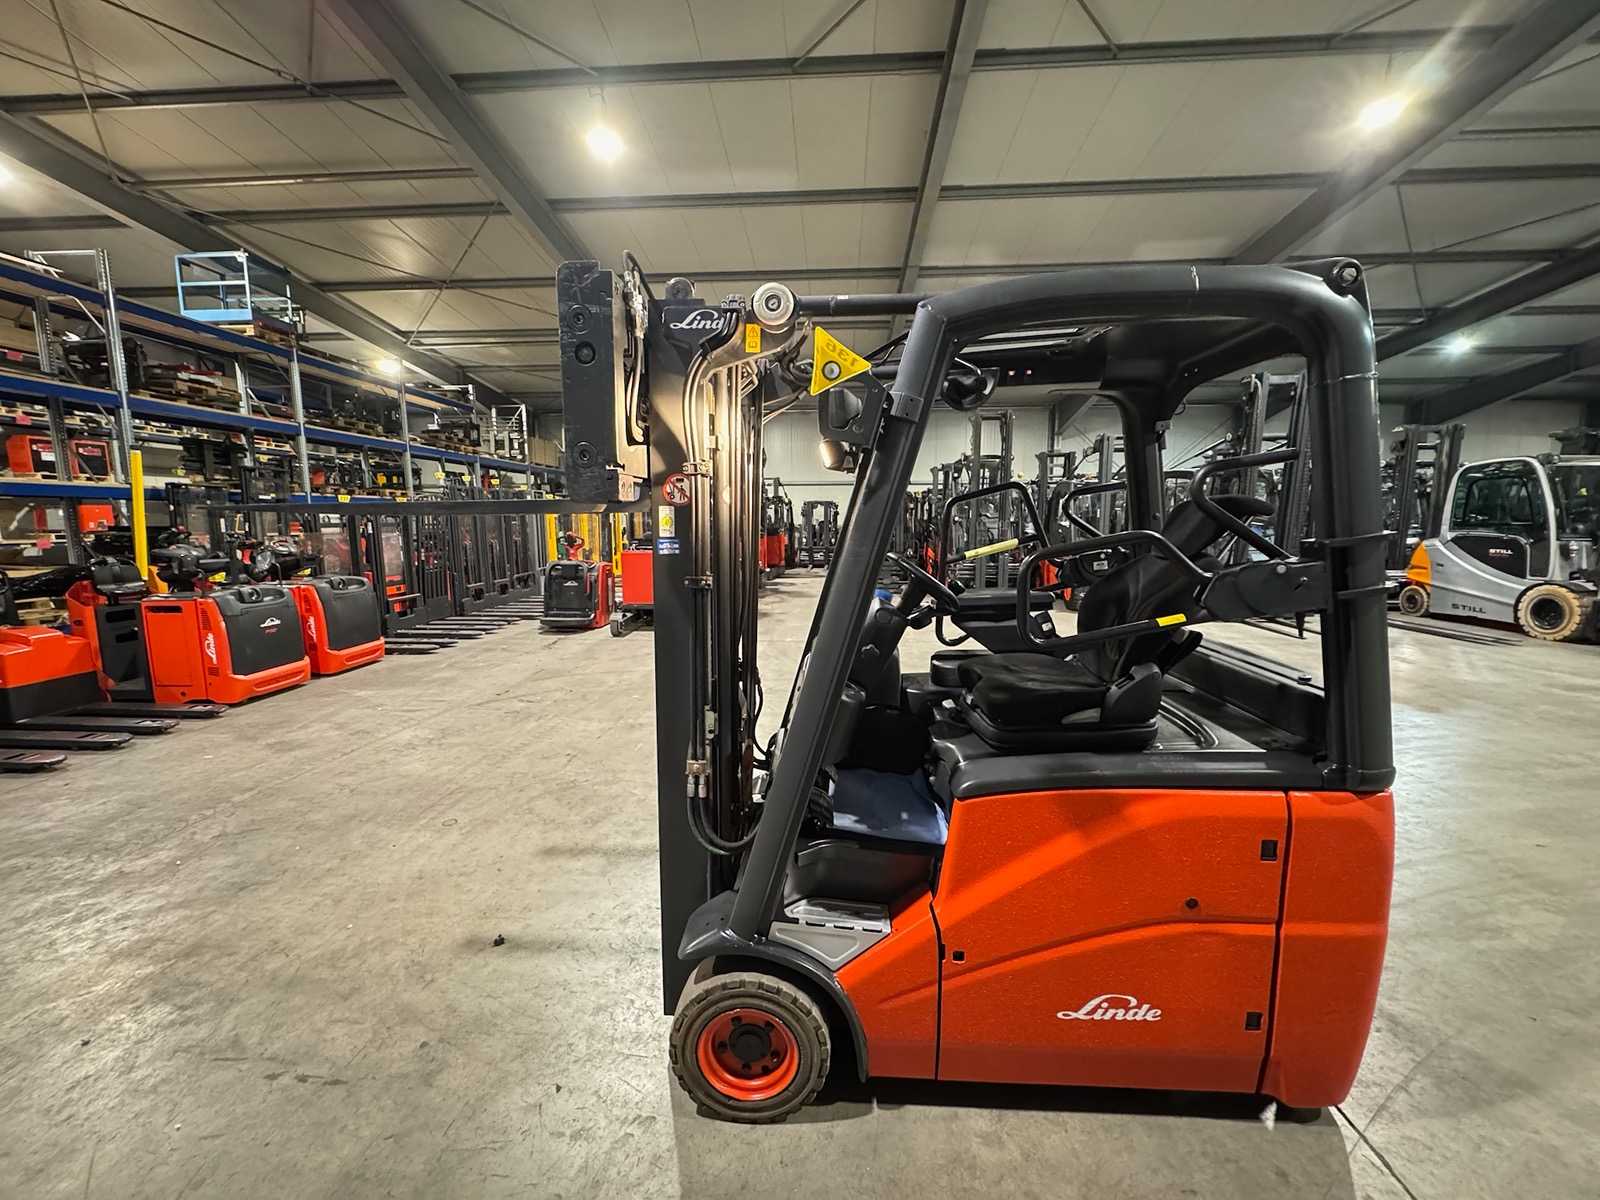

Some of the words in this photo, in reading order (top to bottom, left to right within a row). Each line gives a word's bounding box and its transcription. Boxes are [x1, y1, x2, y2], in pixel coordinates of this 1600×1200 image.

[670, 309, 724, 329] Lind
[1451, 603, 1487, 615] STILL
[1056, 994, 1162, 1021] Linde
